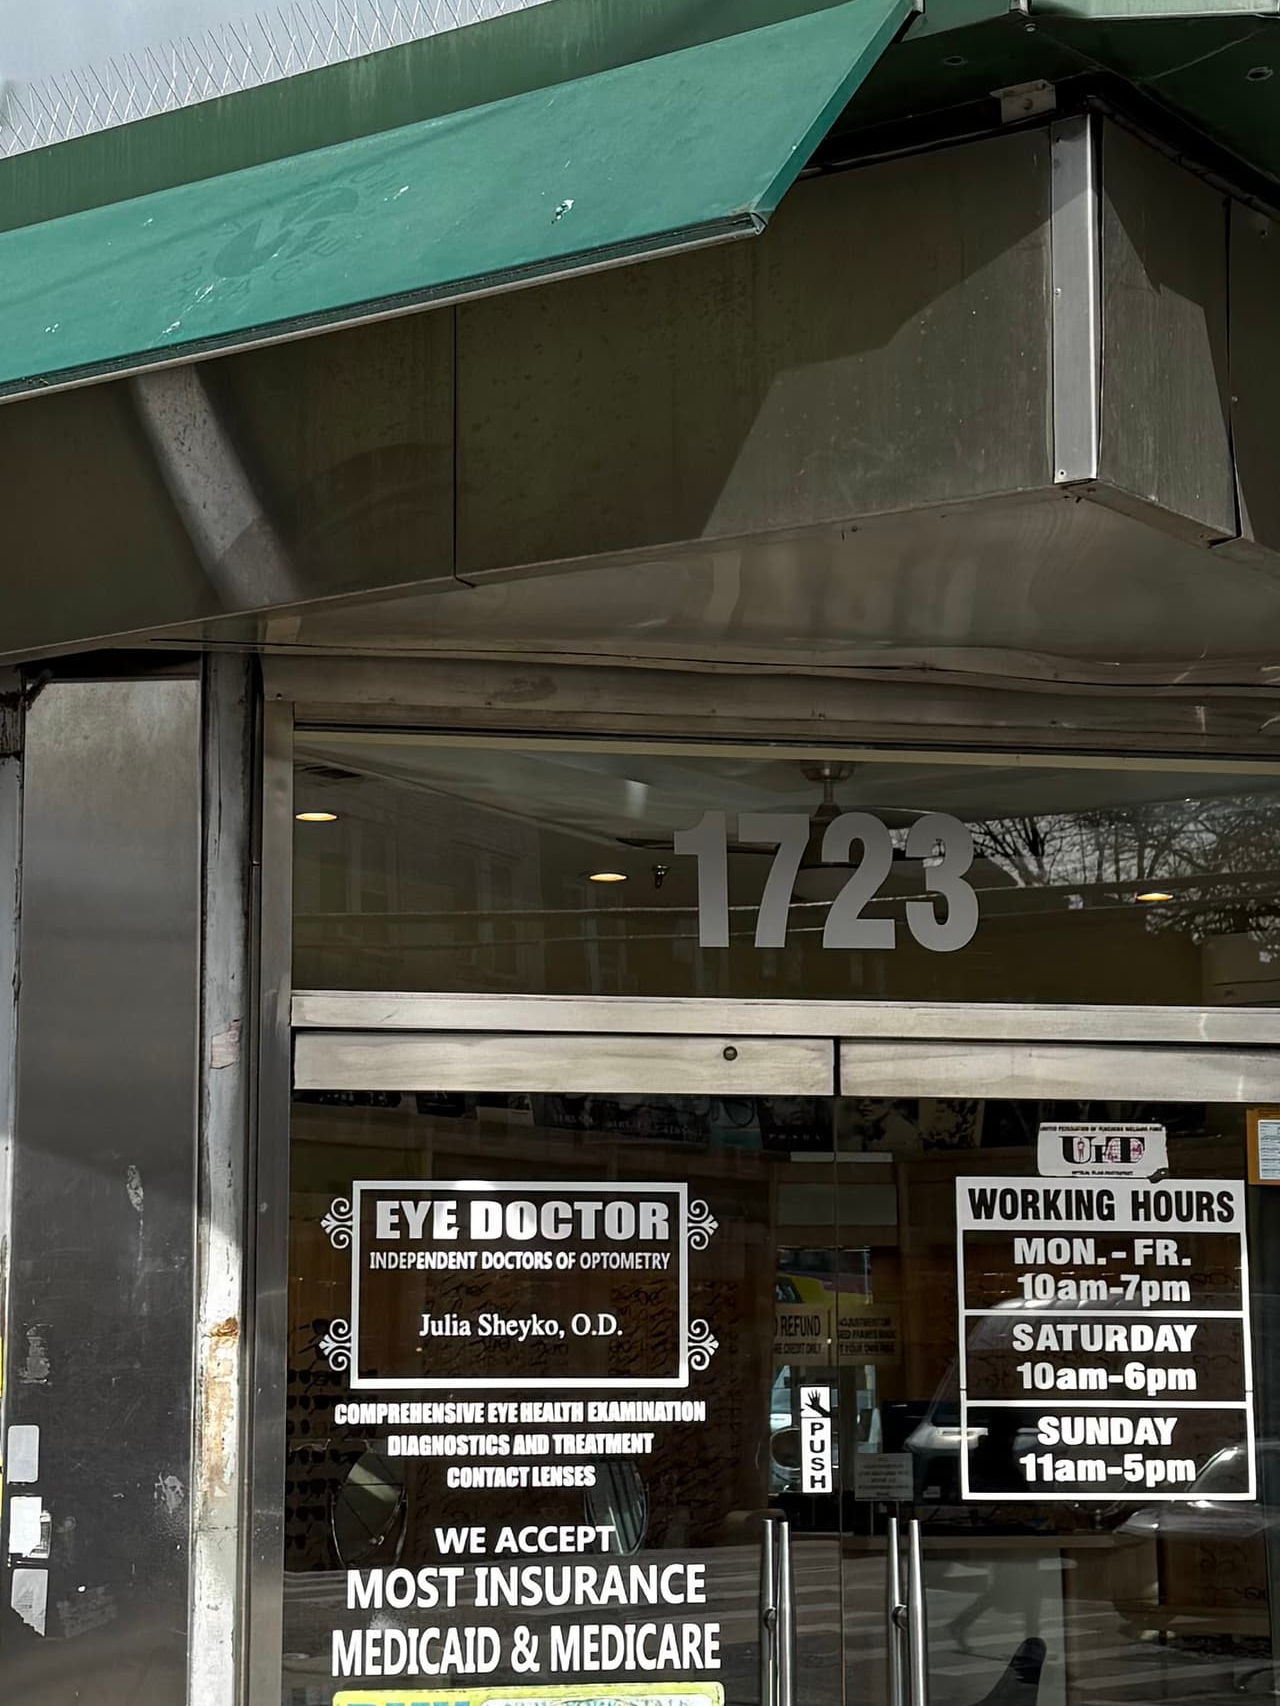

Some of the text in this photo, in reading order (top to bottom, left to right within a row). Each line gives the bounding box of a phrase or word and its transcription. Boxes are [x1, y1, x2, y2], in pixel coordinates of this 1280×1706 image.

[674, 809, 979, 953] 1723
[1059, 1136, 1145, 1164] UFT
[375, 1199, 669, 1241] EYE DOCTOR
[968, 1188, 1234, 1223] WORKING HOURS
[369, 1251, 671, 1270] INDEPENDENT DOCTORS OF OPTOMETRY
[1017, 1274, 1191, 1304] 10am-7pm
[418, 1312, 623, 1342] Julia Sheyko, O.D.
[780, 1315, 821, 1337] REFUND
[1012, 1324, 1197, 1353] SATURDAY
[1016, 1363, 1197, 1396] 10am-6pm
[334, 1400, 706, 1425] COMPREHENSIVE EYE HEALTH EXAMINATION
[387, 1432, 655, 1457] DIAGNOSTICS AND TREATMENT
[1037, 1416, 1178, 1447] SUNDAY
[809, 1422, 827, 1489] PUSH
[447, 1465, 596, 1489] CONTACT LENSES
[1020, 1455, 1197, 1488] 11am-5pm
[435, 1525, 617, 1554] WE ACCEPT
[346, 1564, 707, 1610] MOST INSURANCE
[332, 1623, 721, 1677] MEDICAID & MEDICARE
